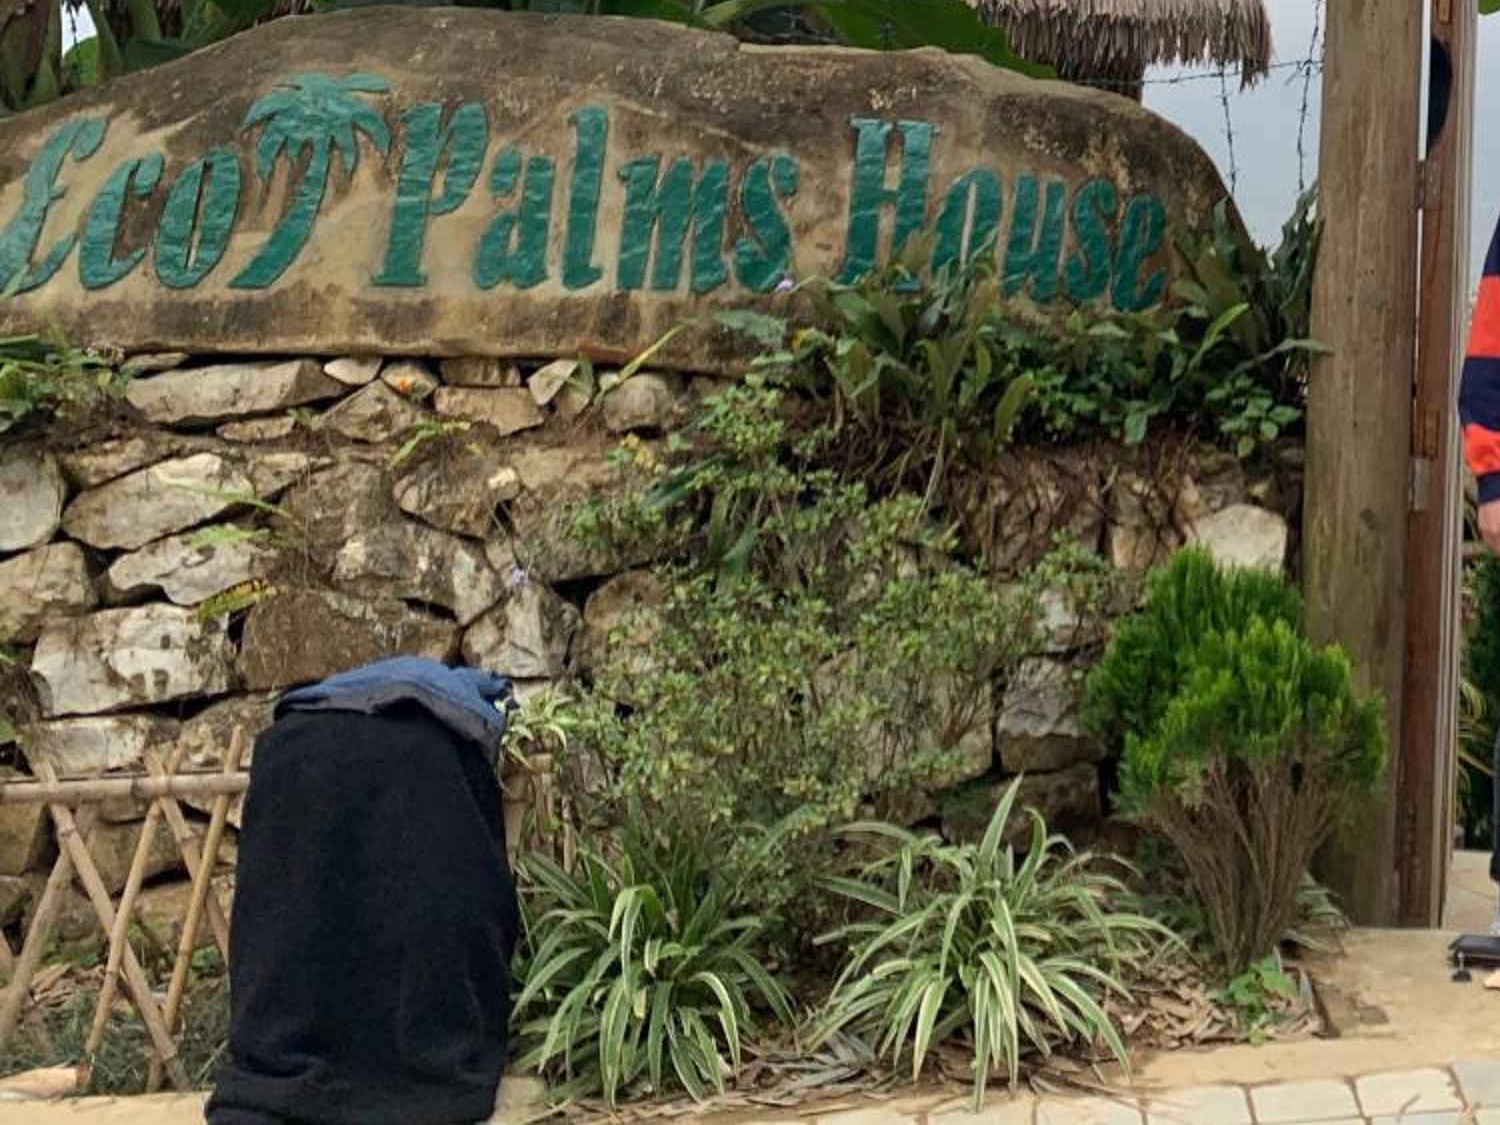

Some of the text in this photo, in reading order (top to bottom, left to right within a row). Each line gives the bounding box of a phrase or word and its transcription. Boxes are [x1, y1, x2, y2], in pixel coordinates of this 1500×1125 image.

[0, 101, 1165, 312] Eco Palms House
